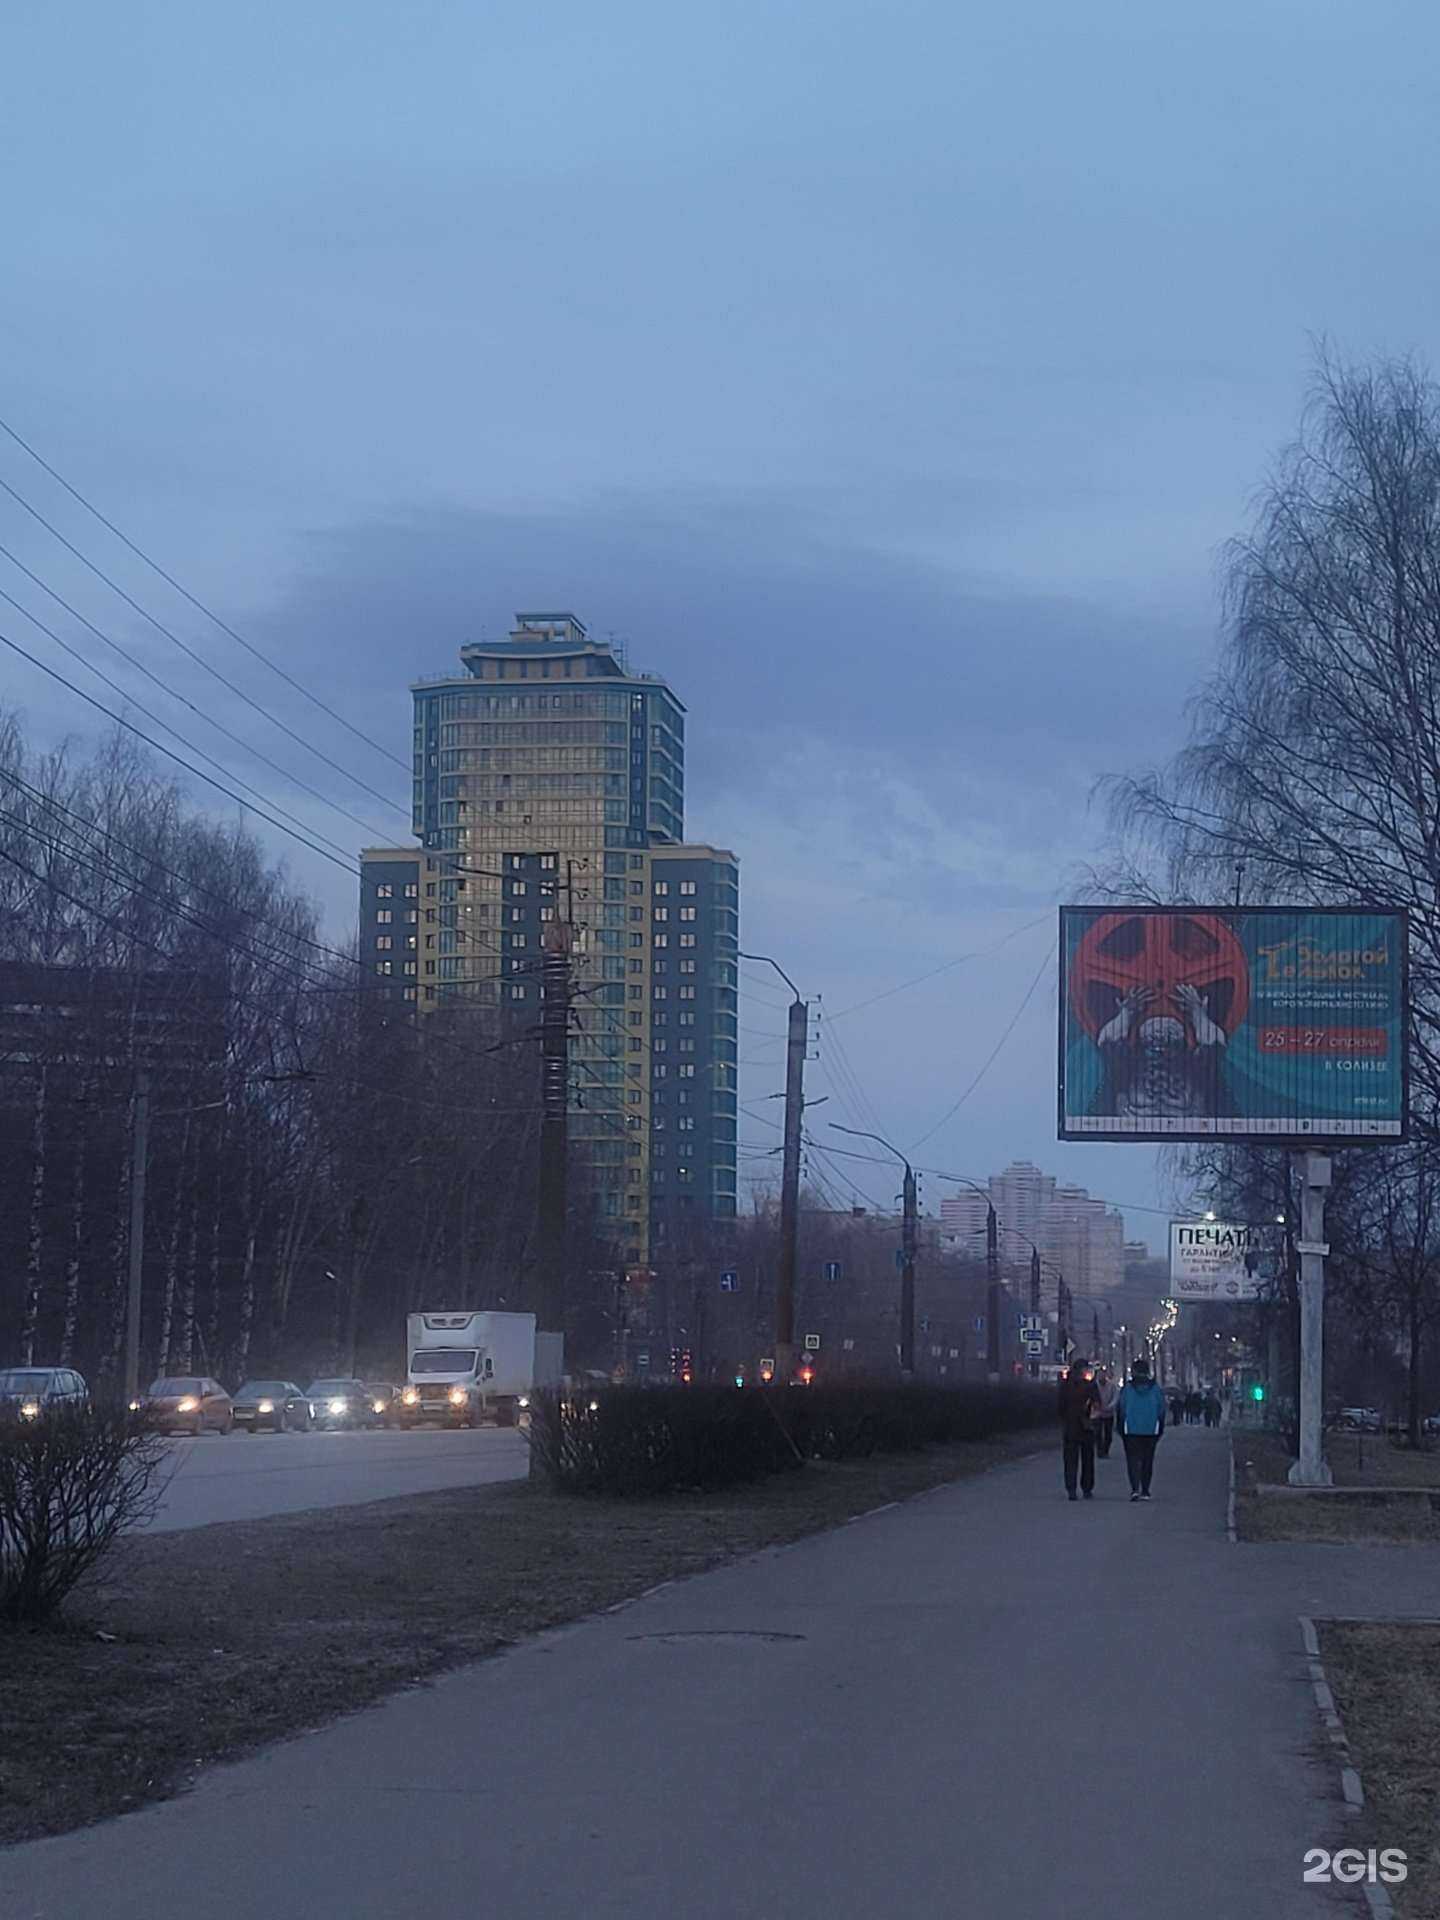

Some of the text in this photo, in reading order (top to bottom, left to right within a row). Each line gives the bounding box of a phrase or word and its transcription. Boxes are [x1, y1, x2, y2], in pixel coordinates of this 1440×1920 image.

[1265, 1031, 1285, 1047] 25
[1304, 1031, 1324, 1047] 27
[1180, 1248, 1233, 1258] ГАРАНТИ
